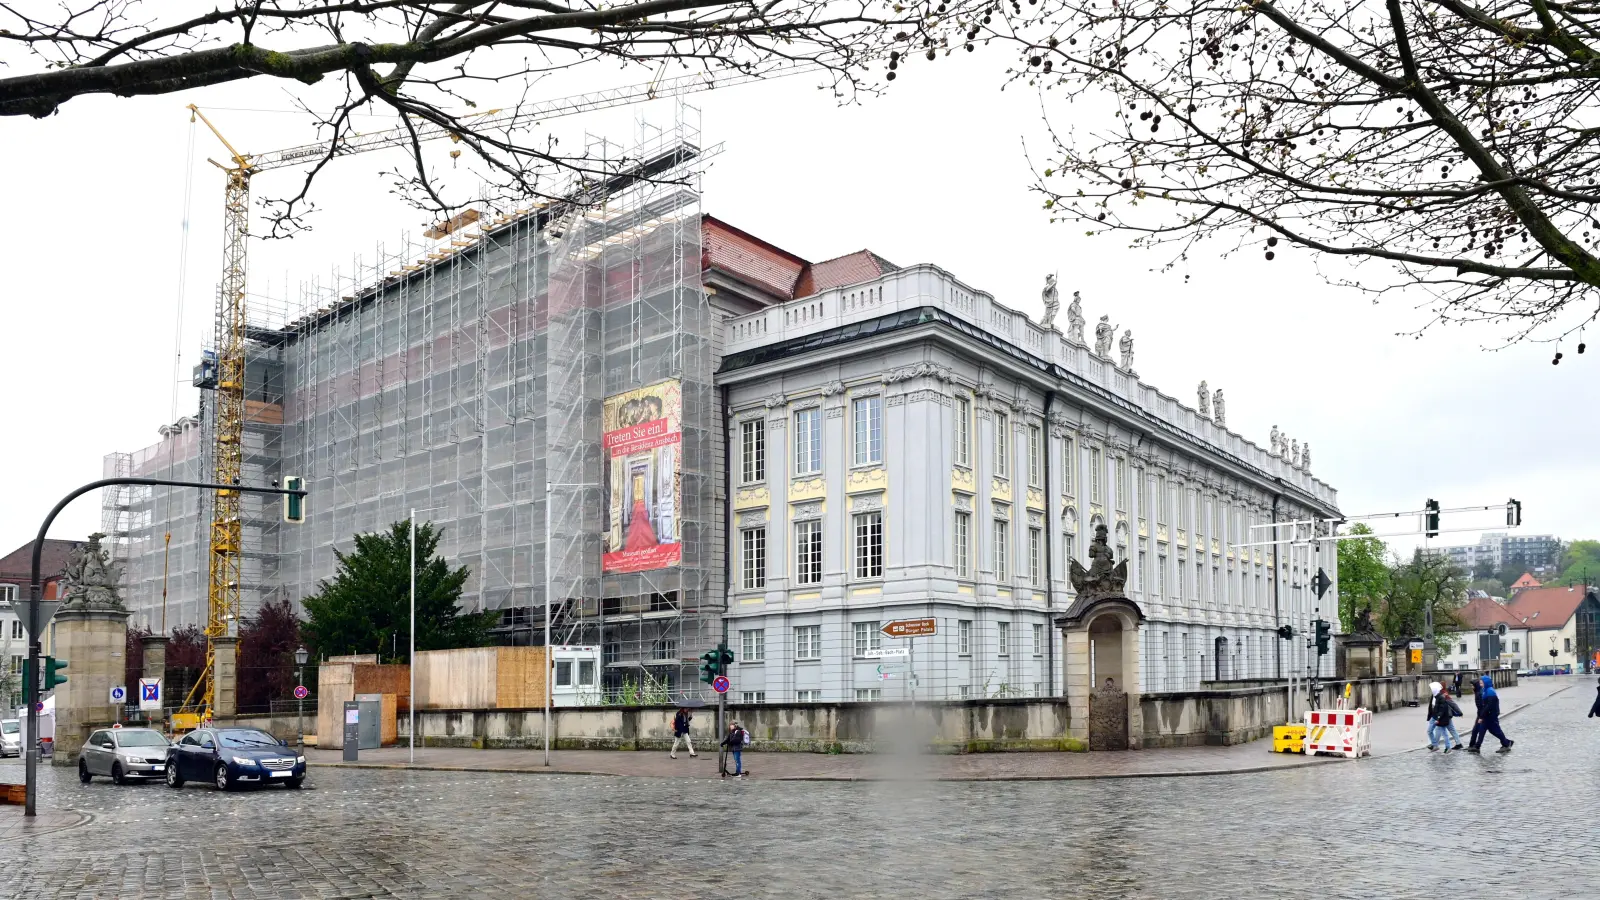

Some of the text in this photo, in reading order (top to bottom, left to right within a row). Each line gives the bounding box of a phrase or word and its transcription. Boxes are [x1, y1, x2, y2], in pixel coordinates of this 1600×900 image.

[282, 148, 323, 160] ECKERT BAU
[607, 421, 663, 446] Treten Sie ein!
[622, 446, 630, 454] die
[631, 442, 654, 452] Residenz
[654, 434, 678, 446] Ansbach
